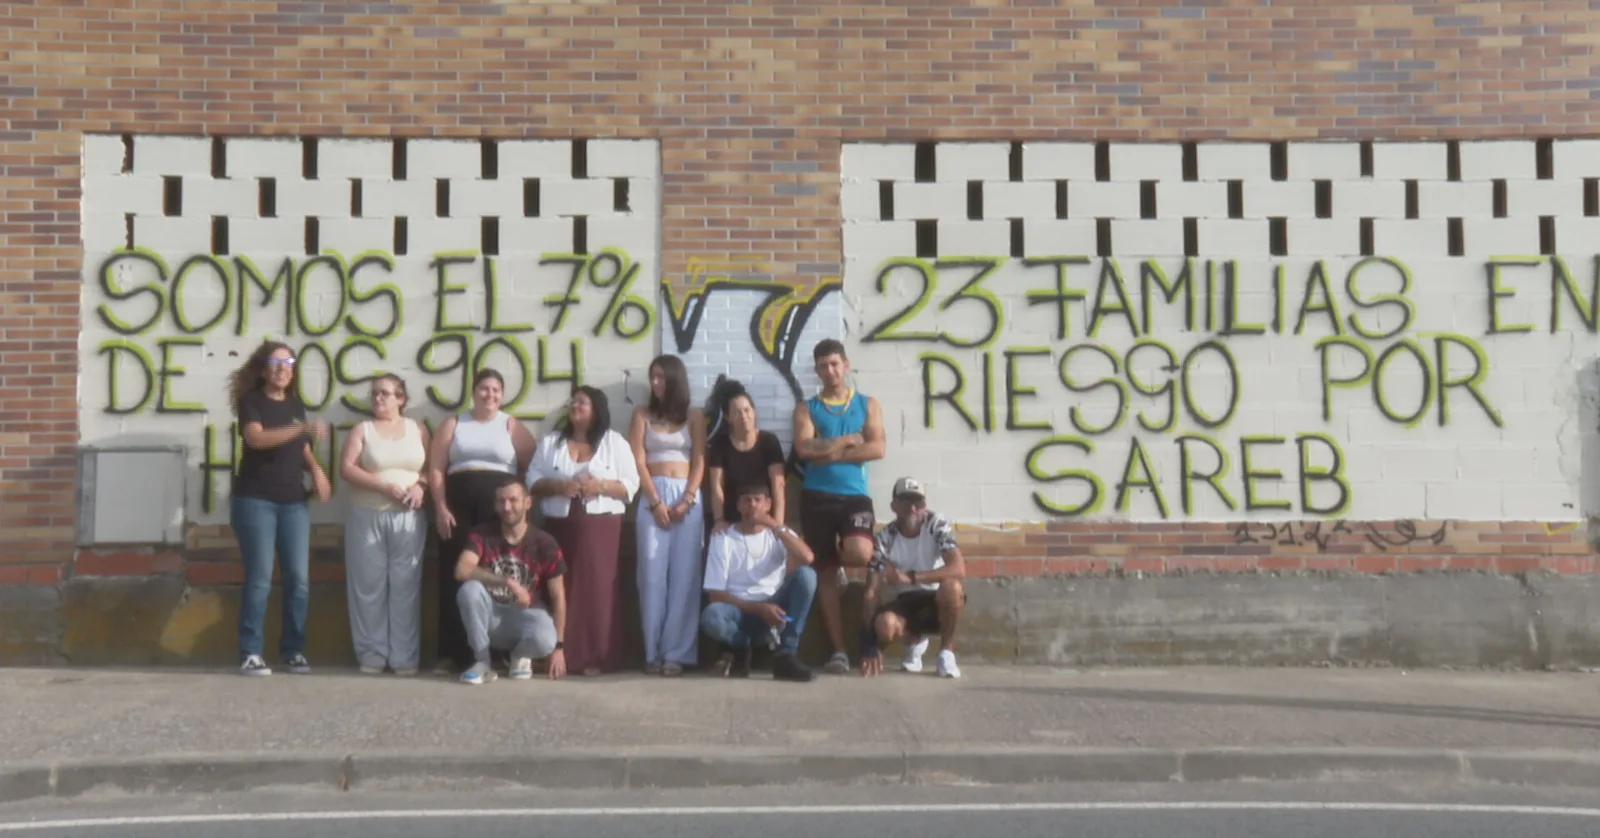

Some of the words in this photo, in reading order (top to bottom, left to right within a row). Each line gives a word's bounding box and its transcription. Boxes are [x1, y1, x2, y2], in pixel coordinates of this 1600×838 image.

[97, 246, 400, 340] SOMOS
[429, 250, 534, 333] EL
[538, 246, 656, 341] 7%
[861, 254, 1004, 349] 23
[1024, 256, 1415, 341] FAMILIAS
[1484, 253, 1600, 336] EN
[99, 336, 206, 414] DE
[258, 334, 388, 420] OS
[416, 331, 584, 414] 904
[920, 340, 1241, 435] RIESGO
[1314, 333, 1505, 429] POR
[1025, 431, 1352, 518] SAREB
